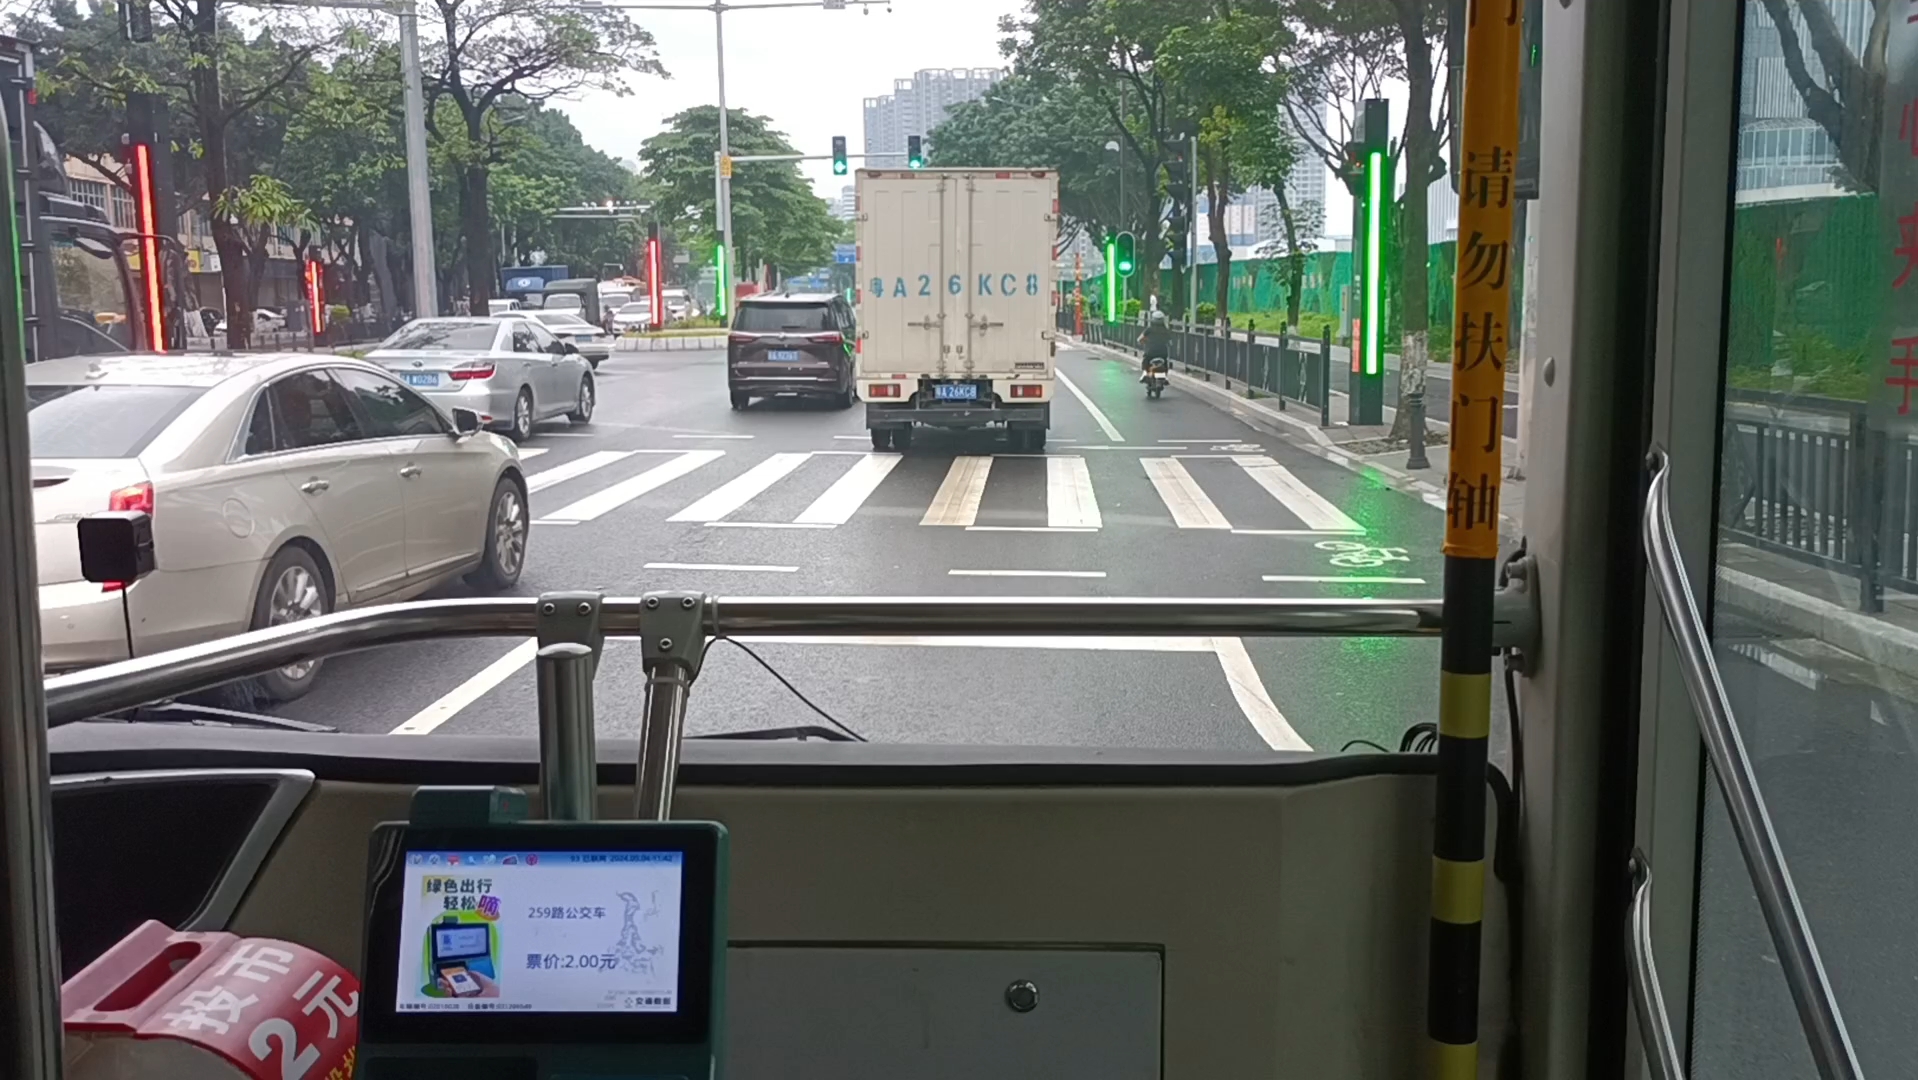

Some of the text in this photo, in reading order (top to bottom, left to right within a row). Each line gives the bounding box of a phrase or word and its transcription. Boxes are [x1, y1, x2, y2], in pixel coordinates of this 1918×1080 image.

[1448, 146, 1513, 530] 请勿扶门轴
[427, 878, 493, 894] 绿色出行
[528, 906, 606, 920] 259路公交车
[526, 953, 618, 970] 票价:2.00元
[162, 943, 294, 1035] 投币
[248, 970, 359, 1080] 2元
